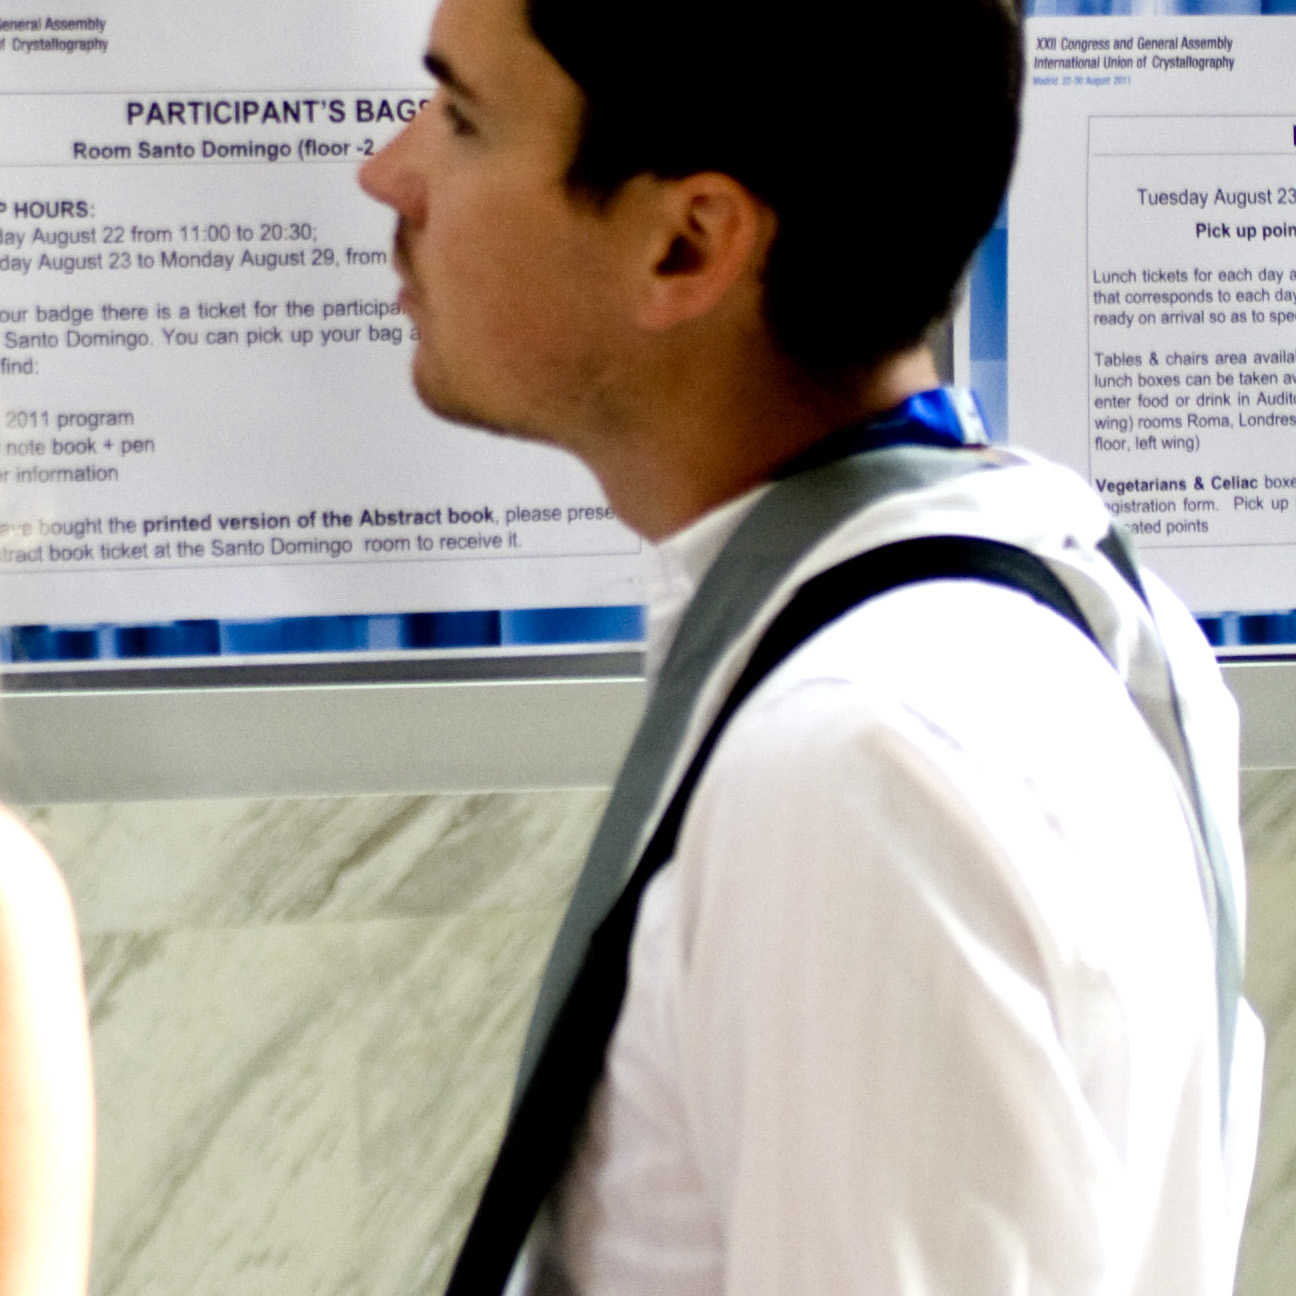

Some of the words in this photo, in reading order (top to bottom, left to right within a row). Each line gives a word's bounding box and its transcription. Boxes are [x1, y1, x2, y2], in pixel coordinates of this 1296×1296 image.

[1036, 37, 1056, 49] XXII
[1061, 37, 1110, 53] Congress
[1113, 37, 1133, 49] and
[1137, 37, 1178, 49] General
[1181, 37, 1233, 52] Assembly
[1034, 56, 1100, 69] International
[1104, 56, 1133, 69] Union
[1137, 56, 1147, 69] of
[1152, 56, 1234, 72] Crystallography
[126, 99, 346, 125] PARTICIPANT'S
[72, 142, 131, 159] Room
[138, 142, 195, 158] Santo
[202, 140, 291, 162] Domingo
[298, 140, 350, 160] (floor
[1137, 187, 1208, 210] Tuesday
[1214, 187, 1272, 209] August
[1277, 187, 1296, 205] 23
[13, 202, 95, 218] HOURS:
[32, 226, 96, 249] August
[103, 226, 125, 243] 22
[130, 225, 172, 243] from
[180, 224, 231, 242] 11:00
[236, 224, 254, 241] to
[260, 223, 317, 244] 20:30;
[1196, 223, 1230, 238] Pick
[1237, 226, 1256, 241] up
[38, 251, 102, 274] August
[109, 251, 131, 268] 23
[137, 251, 154, 268] to
[160, 250, 234, 272] Monday
[240, 249, 305, 271] August
[311, 248, 339, 268] 29,
[345, 248, 387, 265] from
[1093, 269, 1136, 283] Lunch
[1142, 269, 1188, 283] tickets
[1194, 268, 1212, 282] for
[1218, 268, 1252, 282] each
[1258, 268, 1283, 285] day
[1093, 290, 1120, 304] that
[1125, 289, 1213, 307] corresponds
[1218, 289, 1231, 302] to
[1236, 288, 1270, 302] each
[36, 304, 93, 326] badge
[101, 303, 148, 321] there
[157, 303, 171, 320] is
[179, 306, 190, 319] a
[198, 302, 246, 319] ticket
[254, 301, 277, 318] for
[286, 301, 314, 317] the
[323, 299, 406, 321] participa
[1095, 311, 1133, 328] ready
[1139, 313, 1155, 324] on
[1162, 310, 1204, 324] arrival
[1210, 313, 1225, 324] so
[1231, 313, 1246, 323] as
[1252, 310, 1264, 323] to
[1095, 352, 1142, 366] Tables
[1149, 352, 1159, 366] &
[1166, 351, 1208, 365] chairs
[1215, 354, 1247, 365] area
[1254, 350, 1296, 364] availa
[1095, 373, 1132, 387] lunch
[1138, 373, 1180, 387] boxes
[1186, 375, 1210, 386] can
[1217, 372, 1233, 385] be
[1239, 371, 1277, 385] taken
[1095, 394, 1130, 408] enter
[1138, 394, 1168, 408] food
[1176, 396, 1189, 407] or
[1197, 392, 1230, 406] drink
[1238, 392, 1249, 406] in
[1094, 415, 1134, 433] wing)
[1138, 417, 1183, 429] rooms
[1187, 413, 1233, 430] Roma,
[1094, 436, 1130, 453] floor,
[1135, 436, 1157, 450] left
[1161, 435, 1200, 453] wing)
[1094, 477, 1186, 495] Vegetarians
[1194, 476, 1204, 490] &
[1211, 476, 1258, 490] Celiac
[1234, 496, 1263, 510] Pick
[1272, 499, 1288, 513] up
[108, 516, 136, 534] the
[143, 514, 211, 537] printed
[218, 512, 290, 531] version
[297, 511, 316, 528] of
[322, 510, 353, 528] the
[359, 507, 441, 527] Abstract
[506, 504, 561, 527] please
[1165, 520, 1210, 536] points
